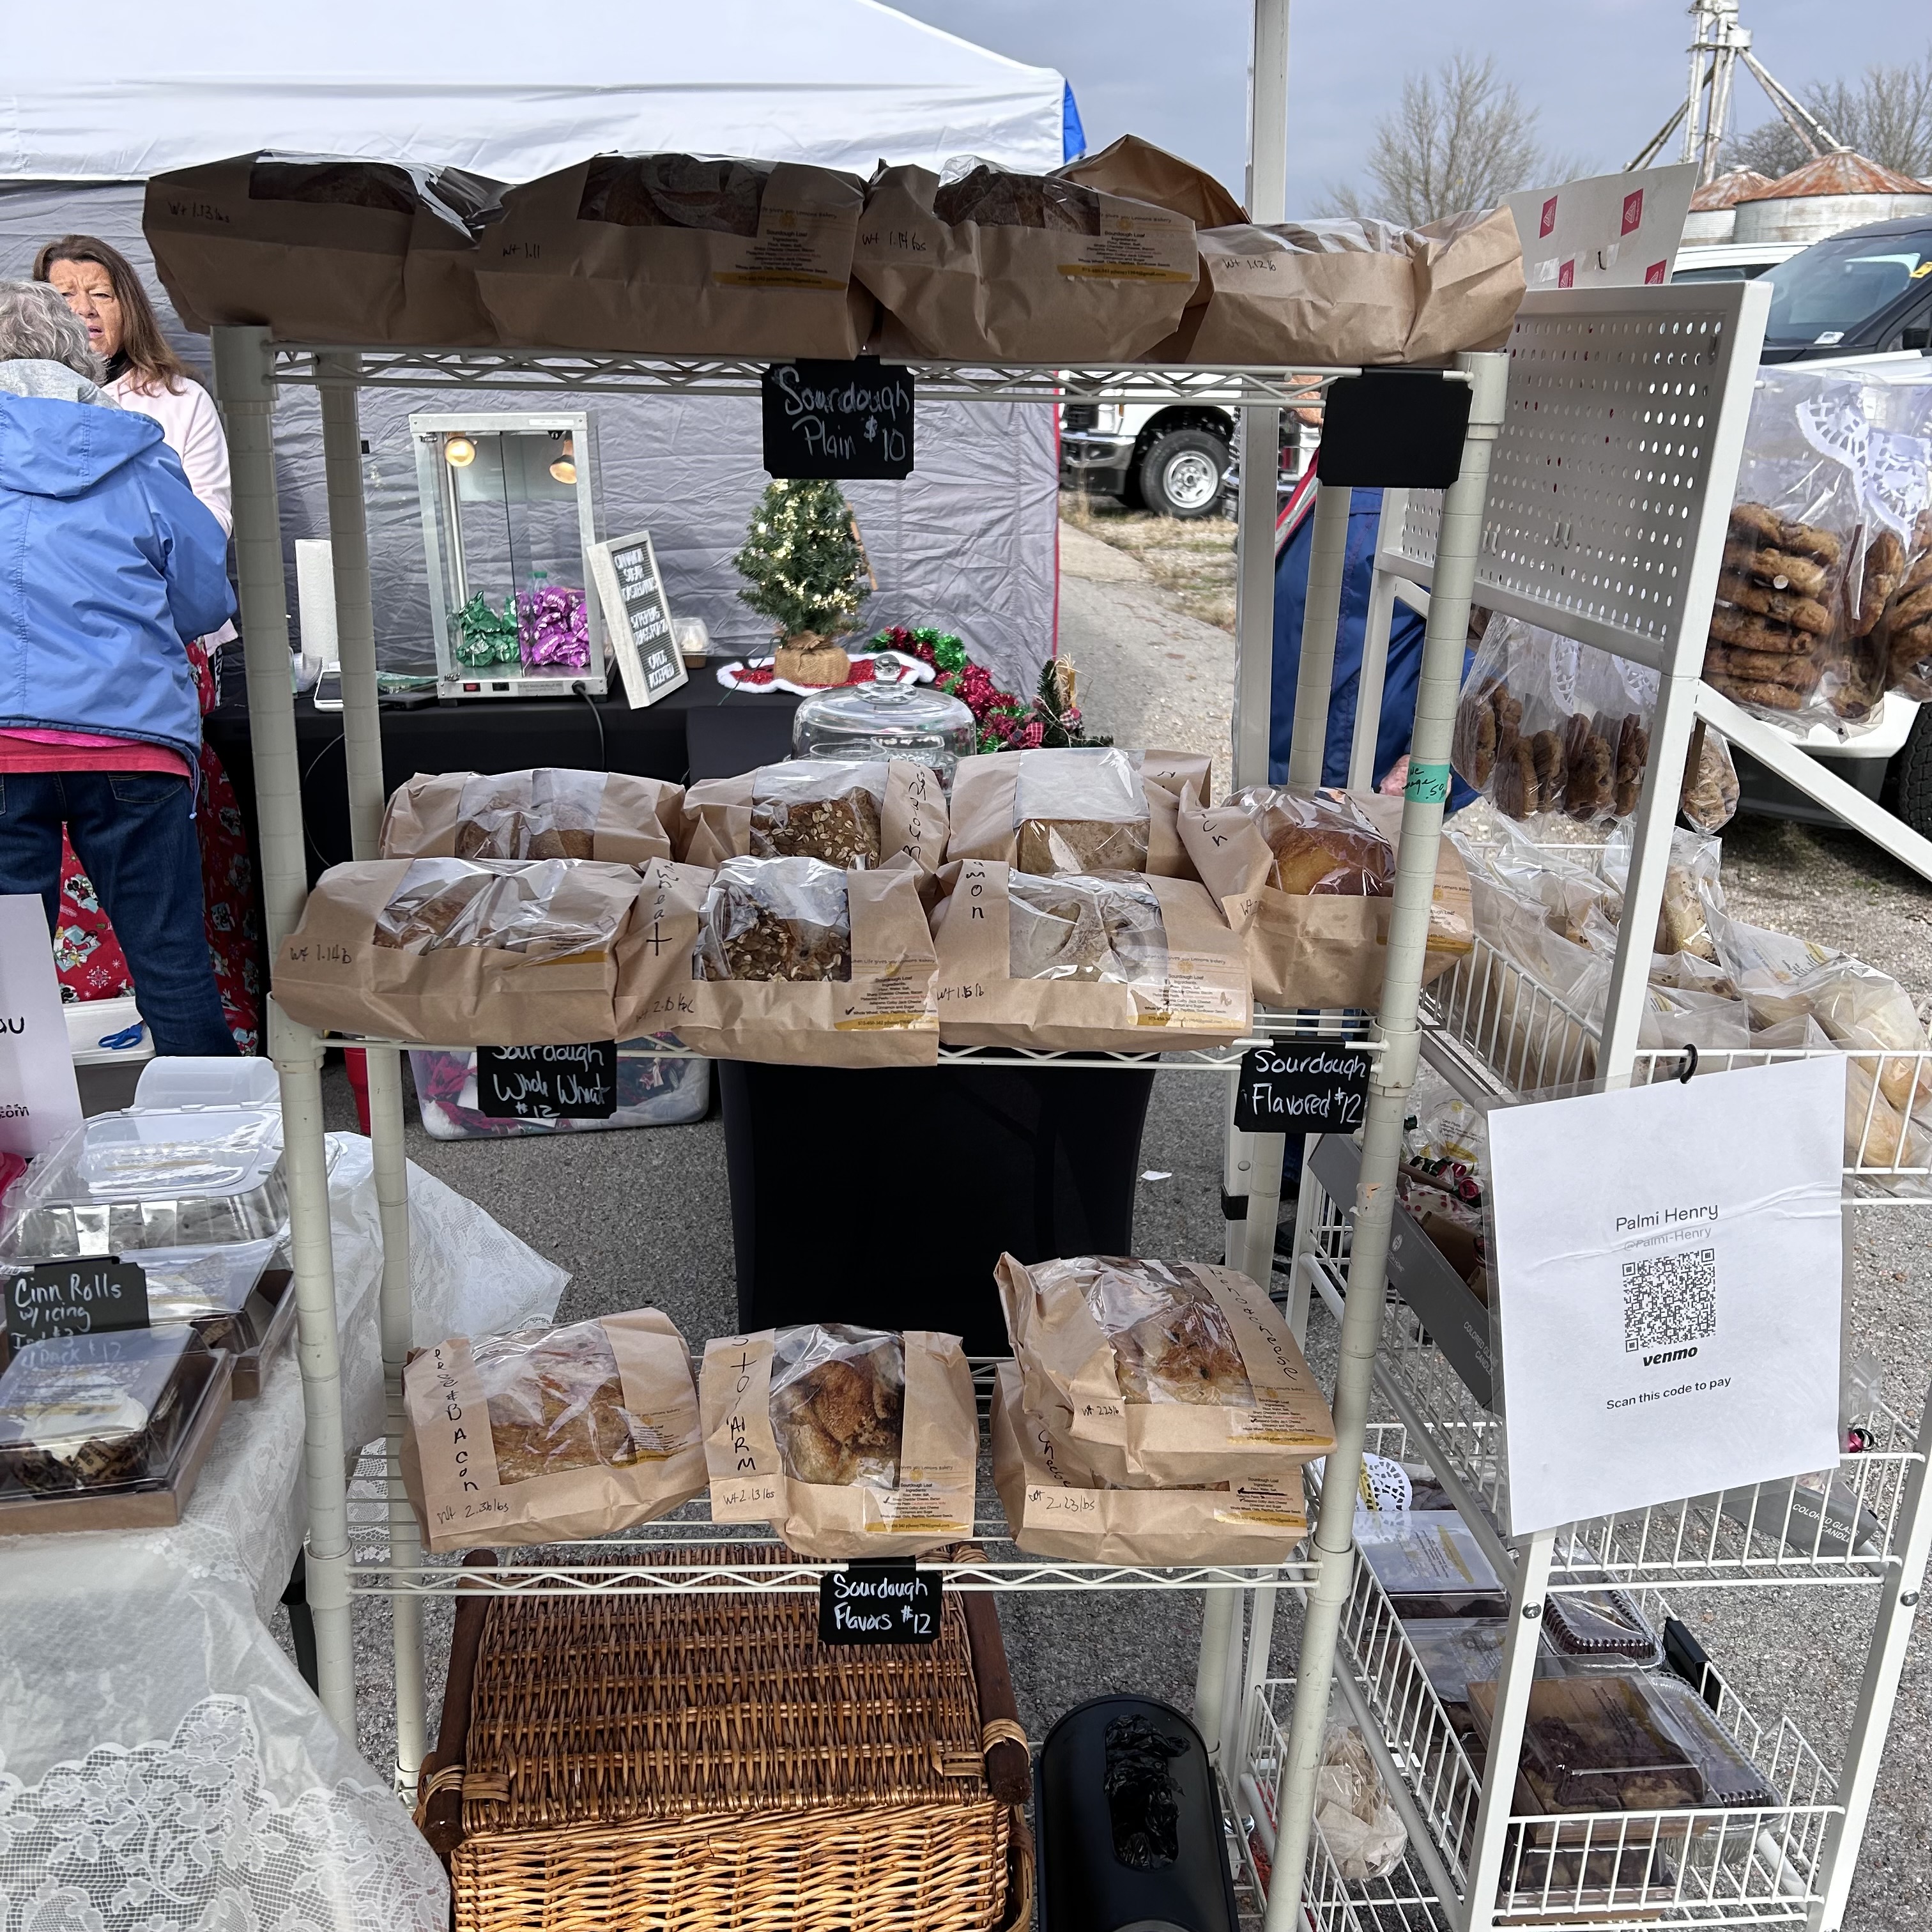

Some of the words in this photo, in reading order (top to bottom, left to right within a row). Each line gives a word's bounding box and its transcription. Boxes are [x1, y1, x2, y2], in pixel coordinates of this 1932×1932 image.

[777, 366, 910, 422] Sourdough
[792, 415, 856, 460] Plain
[492, 1045, 604, 1072] Sourdough
[1255, 1050, 1366, 1081] Sourdough
[1252, 1083, 1331, 1117] Flavored
[1616, 1211, 1660, 1232] Palmi
[1665, 1204, 1719, 1225] Henry
[15, 1277, 63, 1308] Cinn
[70, 1273, 122, 1301] Rolls
[45, 1301, 91, 1332] icing
[1464, 1321, 1485, 1349] COLORED
[1643, 1346, 1698, 1367] venmo
[1606, 1397, 1636, 1410] Scan
[1639, 1392, 1660, 1404] this
[1662, 1384, 1692, 1399] code
[1695, 1381, 1707, 1391] to
[1709, 1377, 1732, 1390] pay
[833, 1573, 928, 1602] Sourdough
[834, 1602, 893, 1631] Flavors
